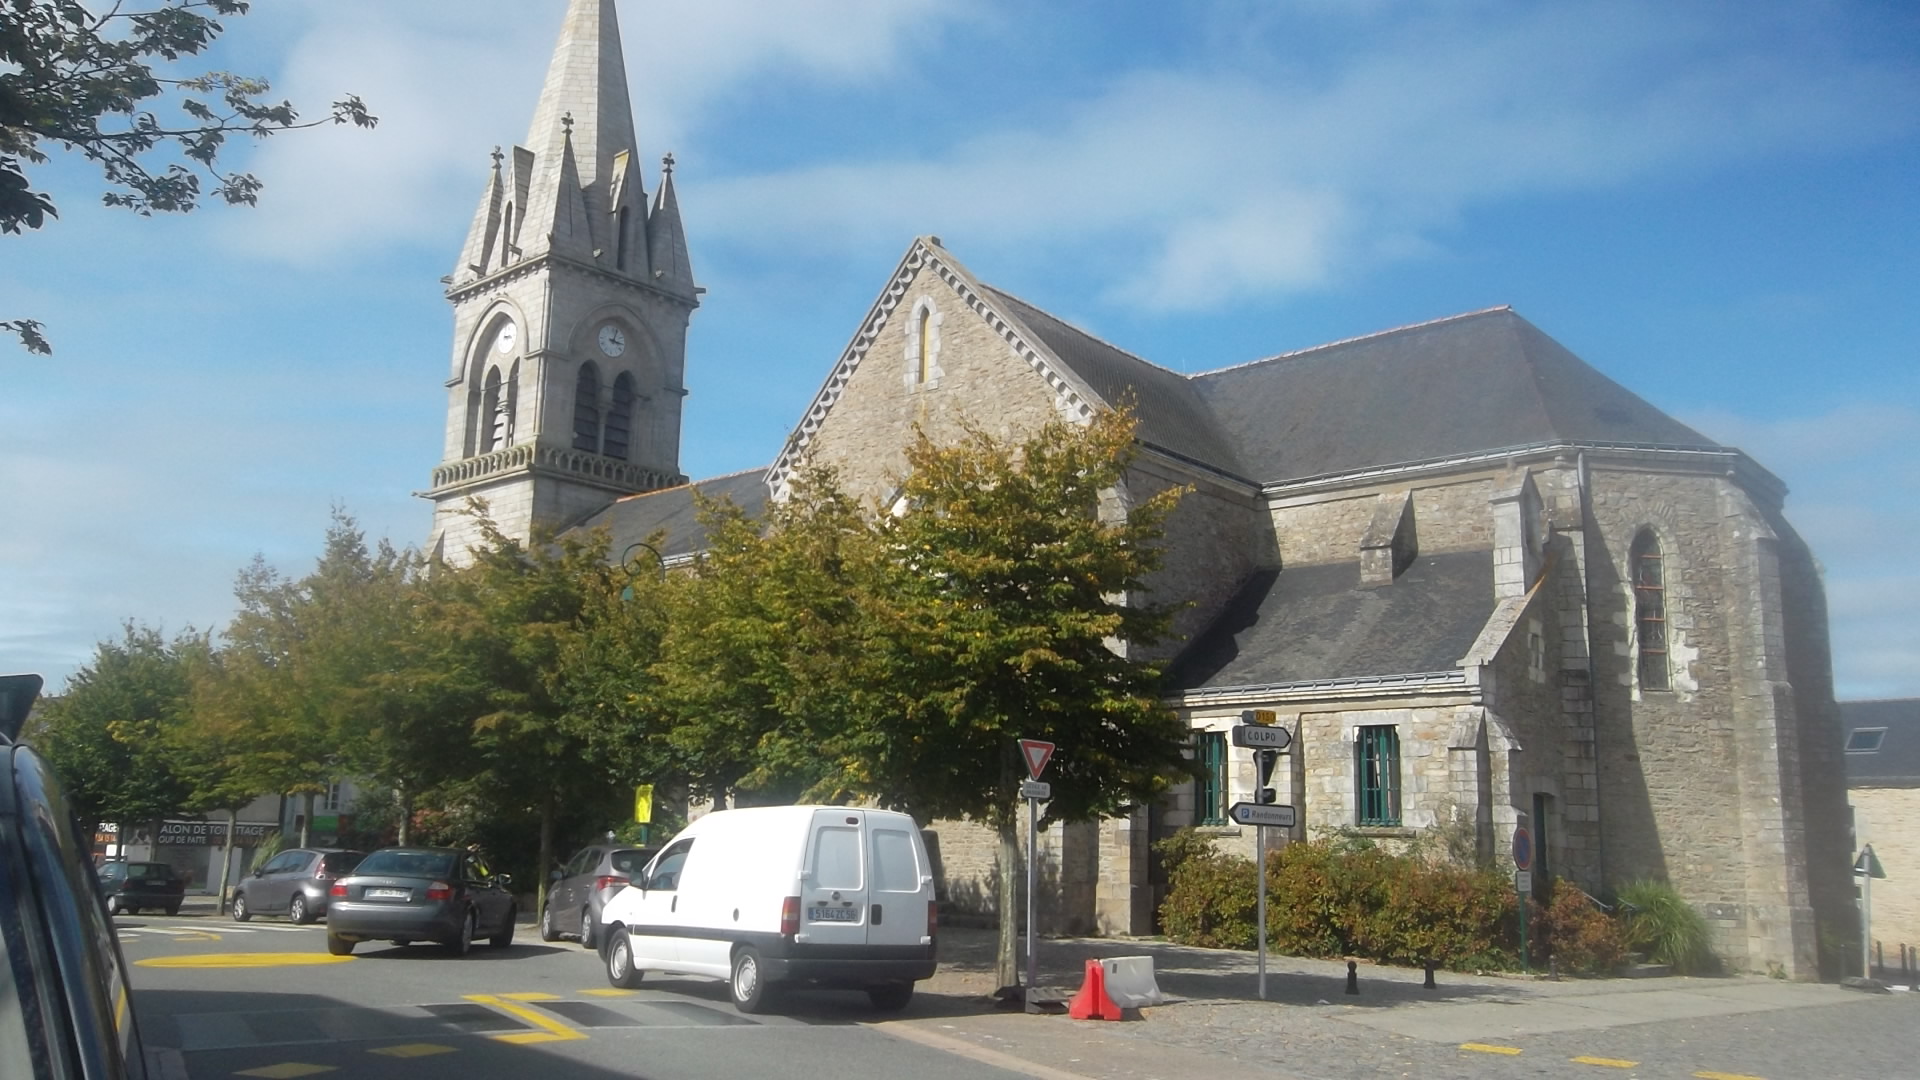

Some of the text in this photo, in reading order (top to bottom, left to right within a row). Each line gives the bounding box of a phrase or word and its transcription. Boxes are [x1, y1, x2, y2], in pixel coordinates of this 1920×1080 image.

[1247, 731, 1276, 742] COLPO
[1251, 810, 1292, 820] Randonneurs
[159, 824, 264, 836] ALON DE TOITTAGE
[158, 835, 175, 844] OUP
[176, 835, 186, 844] DE
